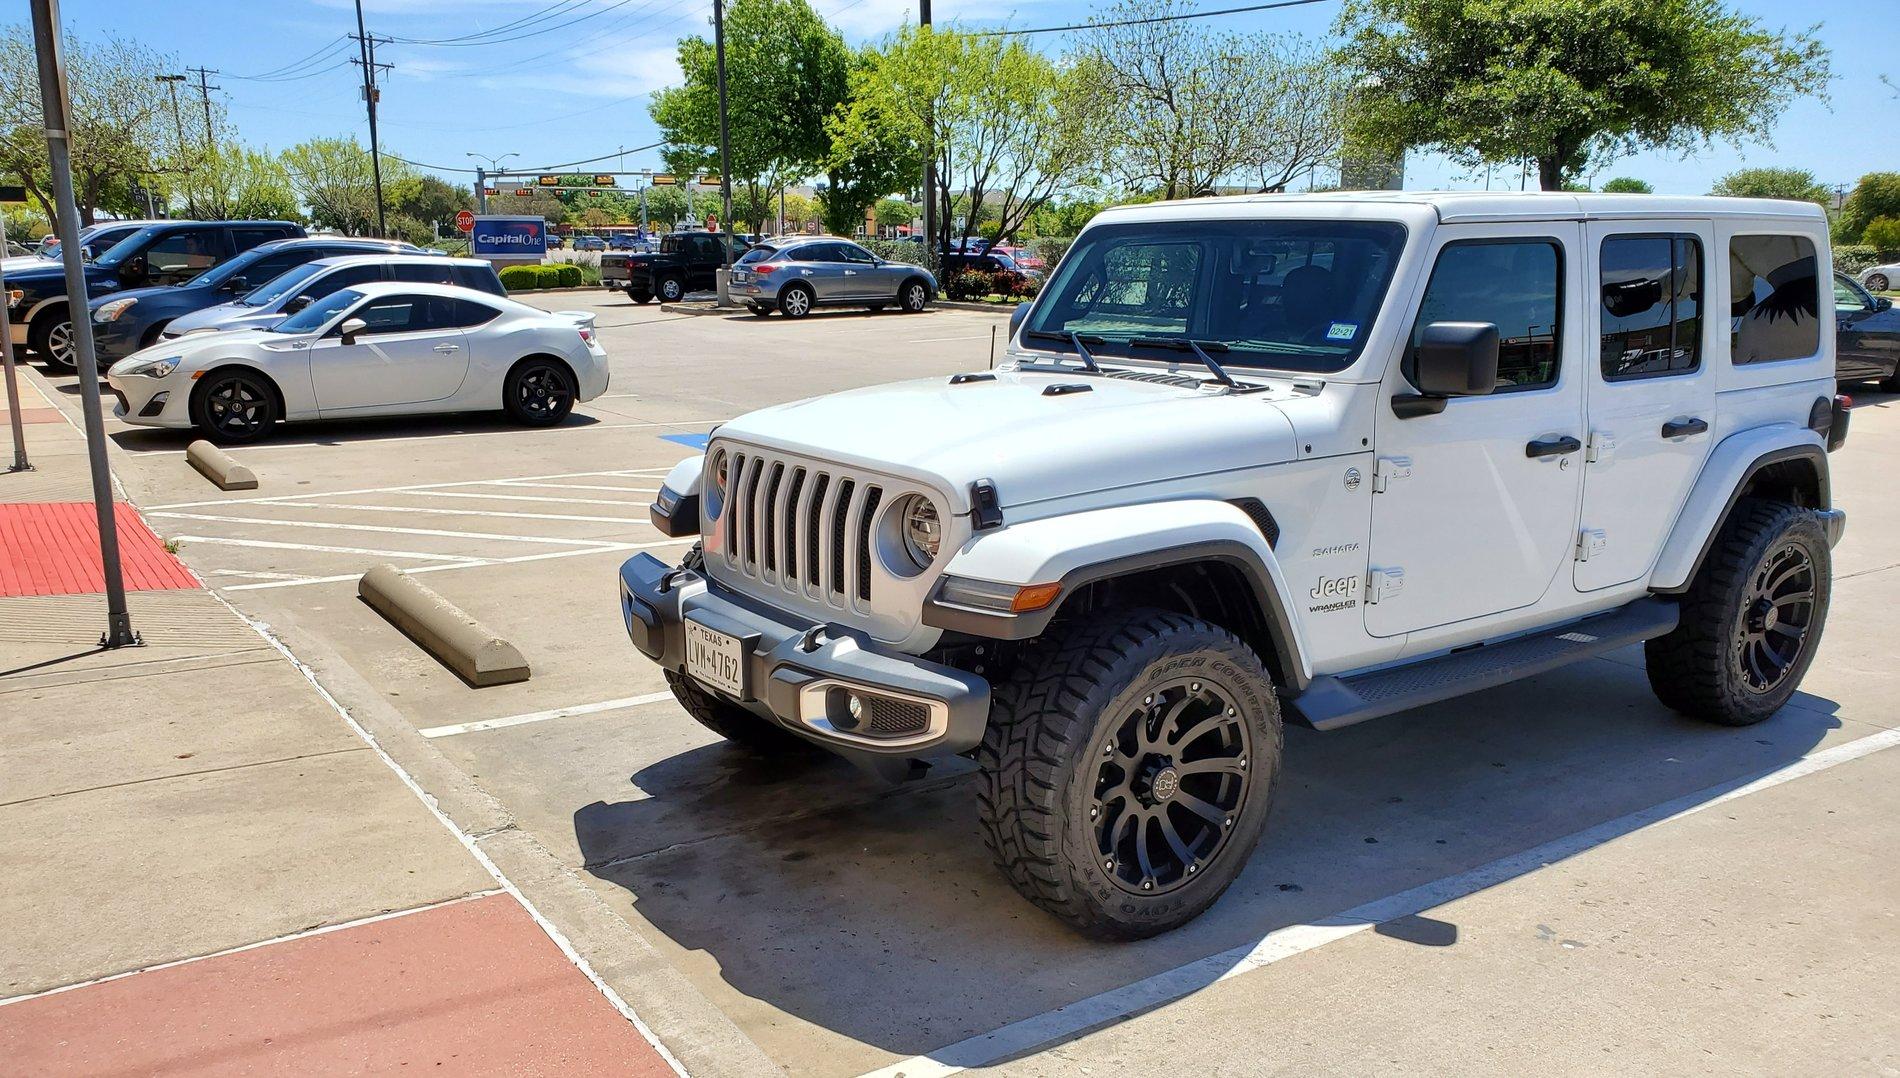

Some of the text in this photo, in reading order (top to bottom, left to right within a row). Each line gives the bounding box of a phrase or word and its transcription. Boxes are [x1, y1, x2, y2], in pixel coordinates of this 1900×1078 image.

[458, 216, 474, 226] STOP
[1312, 542, 1360, 557] SAHARA
[1310, 575, 1359, 599] Jeep
[1309, 600, 1356, 613] WRANGLER
[700, 628, 722, 647] TEXAS
[1150, 657, 1268, 735] OPEN COUNTRY
